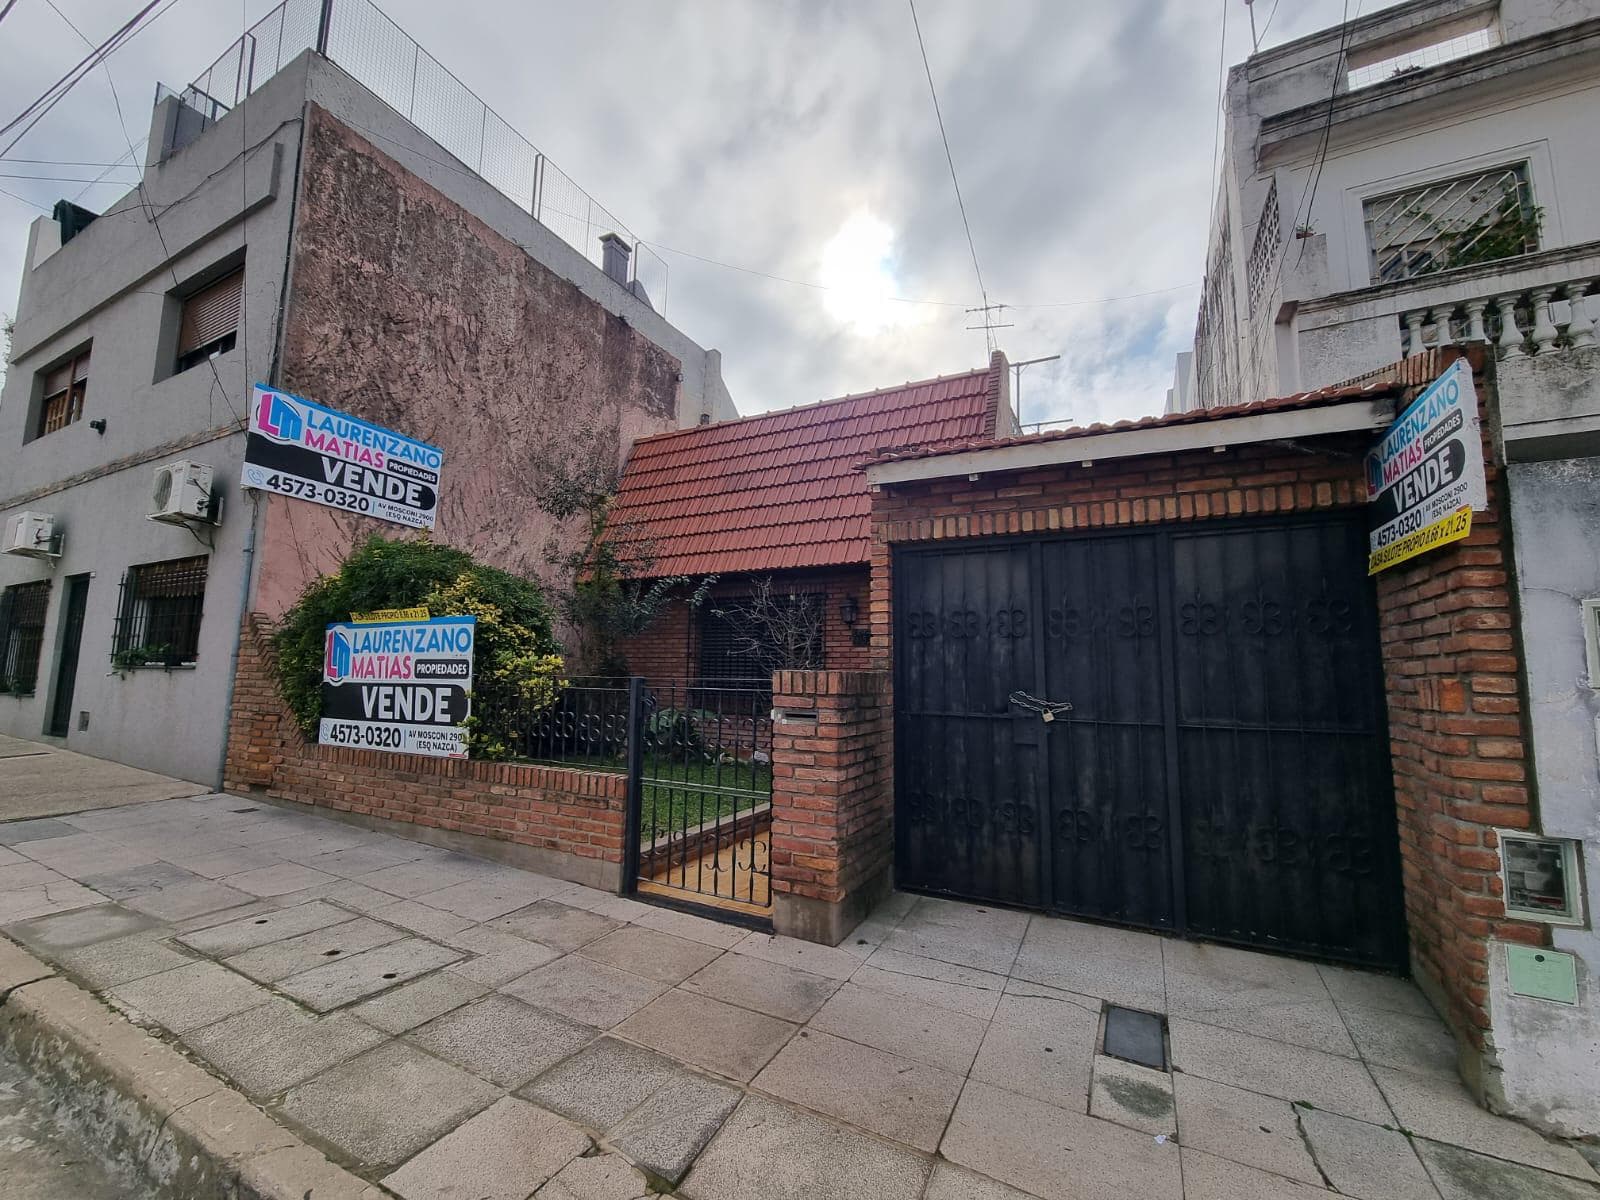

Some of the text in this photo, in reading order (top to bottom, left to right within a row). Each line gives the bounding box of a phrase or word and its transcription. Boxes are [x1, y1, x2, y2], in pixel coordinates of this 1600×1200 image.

[307, 410, 440, 469] LAURENZANO
[1381, 379, 1458, 464] LAURENZANO
[305, 429, 436, 482] MATIAS PROPIEDADES
[1384, 437, 1422, 486] MATIAS
[266, 474, 369, 511] 4573-0320
[321, 456, 422, 507] VENDE
[1392, 446, 1453, 513] VENDE
[388, 505, 417, 517] MOSCONI
[1377, 509, 1421, 548] 4573-0320
[352, 627, 472, 654] LAURENZANO
[351, 655, 467, 679] MATIAS PROPIEDADES
[362, 686, 452, 722] VENDE
[330, 723, 401, 748] 4573-0320
[409, 730, 463, 741] AV MOSCONI 290
[417, 741, 457, 752] (ESQ NAZCA)
